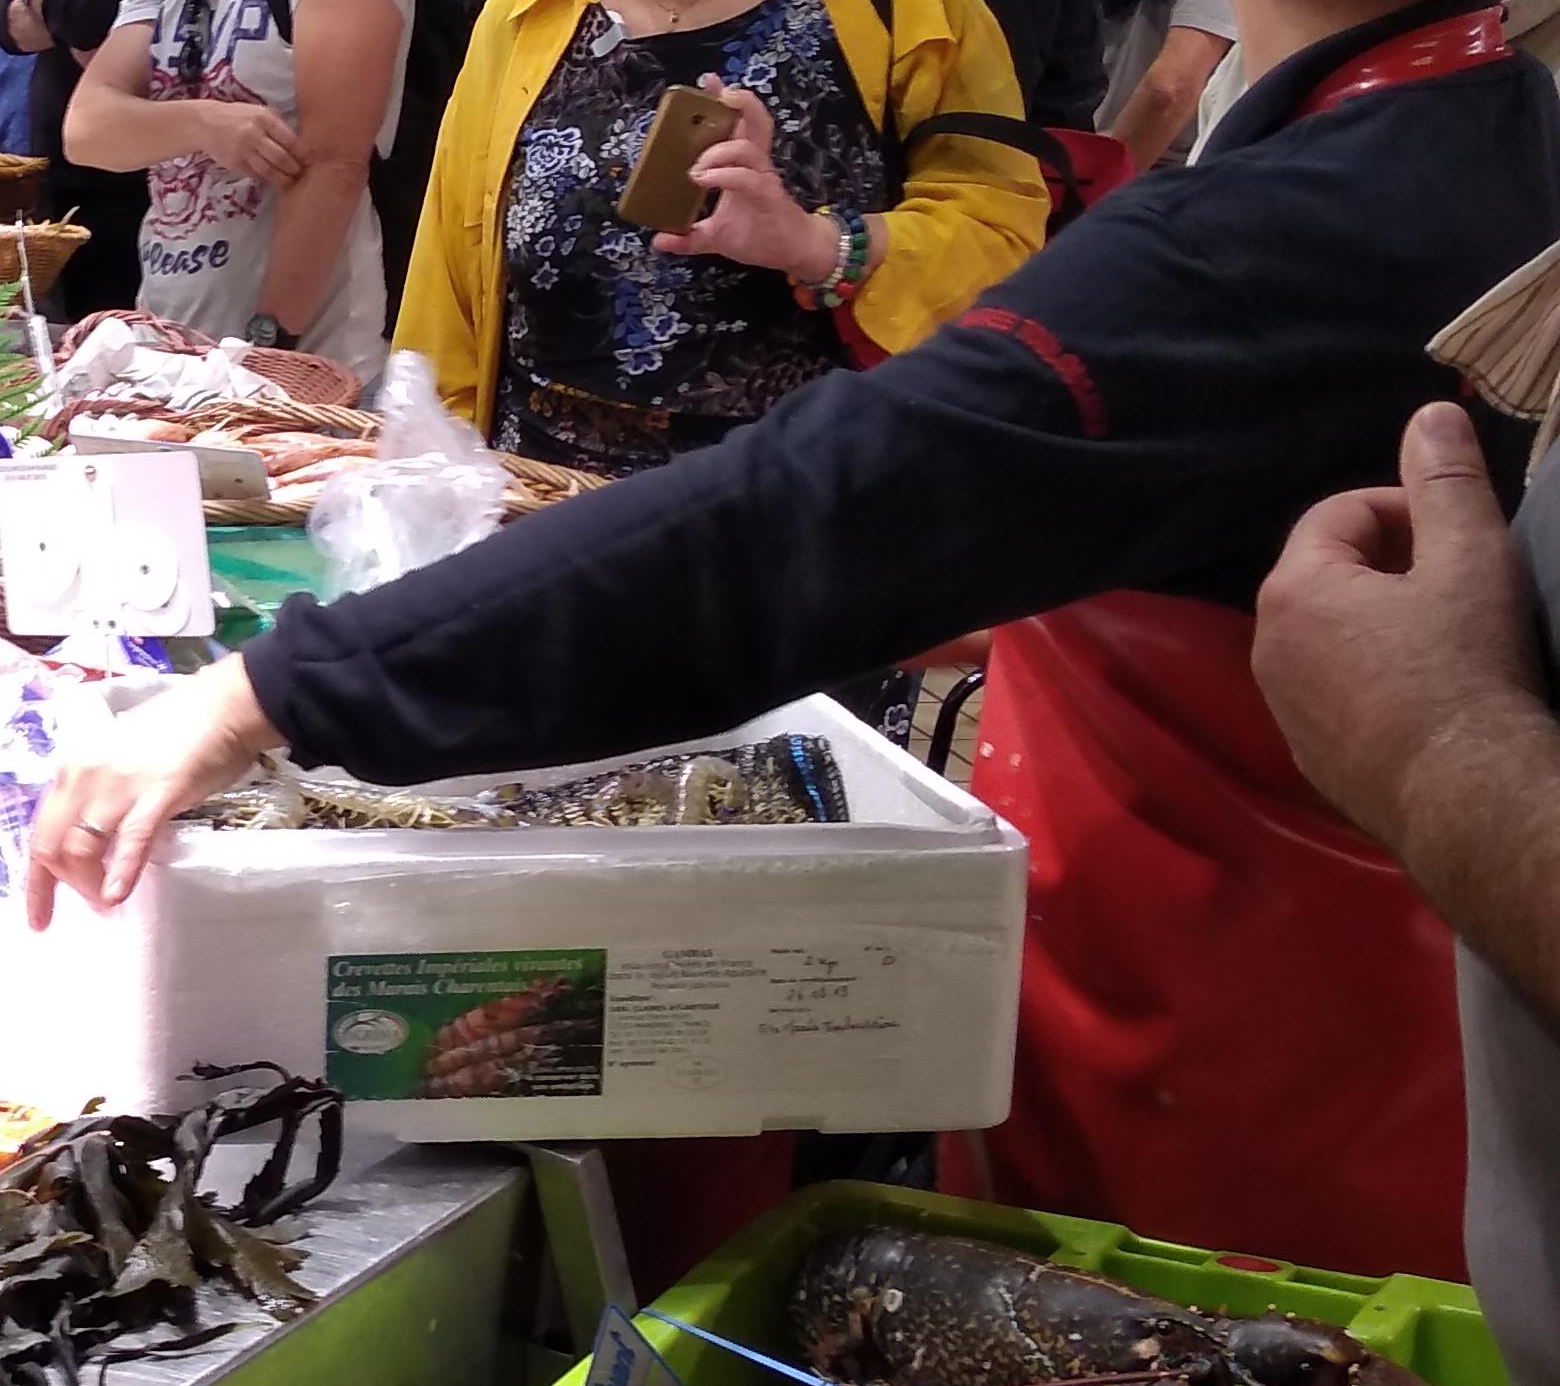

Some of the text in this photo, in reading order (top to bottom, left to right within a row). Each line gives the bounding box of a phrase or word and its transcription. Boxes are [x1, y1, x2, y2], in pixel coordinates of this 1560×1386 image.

[333, 961, 412, 978] Crevettes
[414, 958, 509, 978] Impériales
[331, 982, 362, 997] des
[367, 981, 429, 996] Marais
